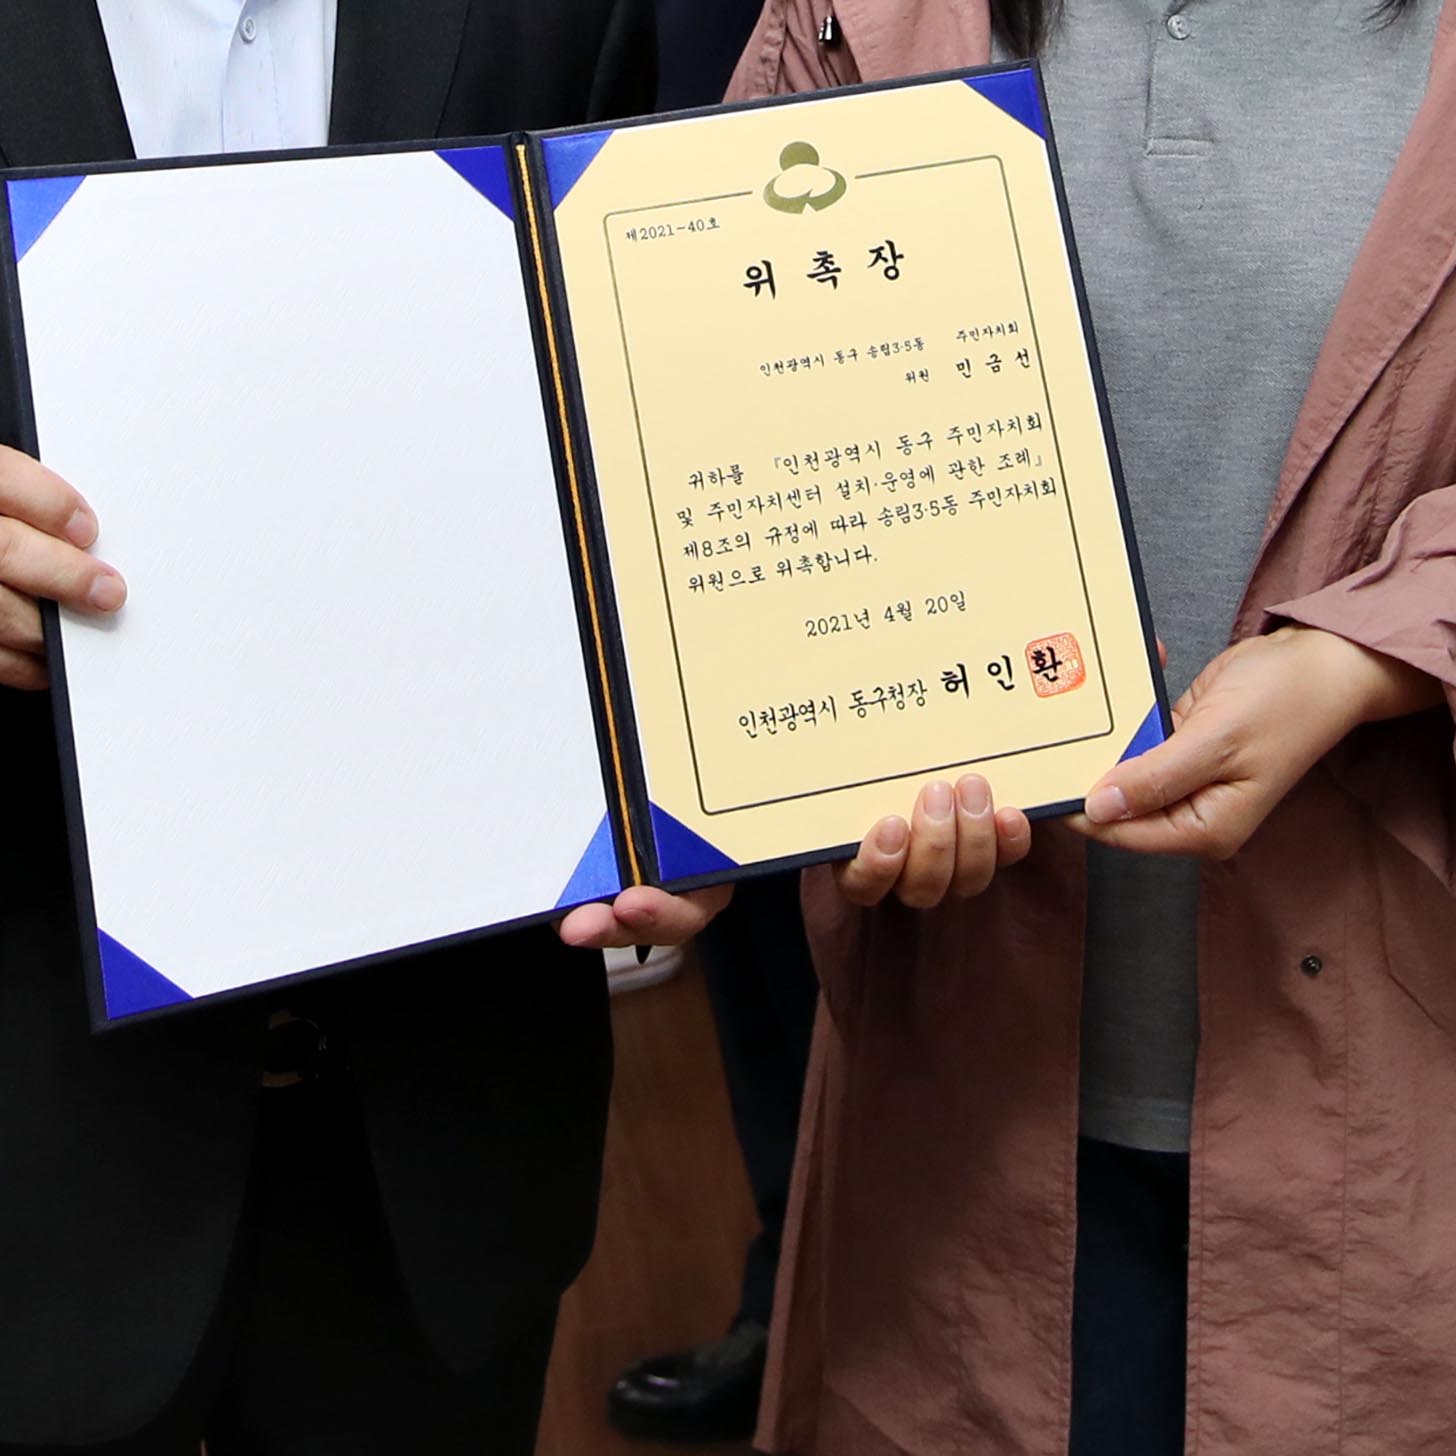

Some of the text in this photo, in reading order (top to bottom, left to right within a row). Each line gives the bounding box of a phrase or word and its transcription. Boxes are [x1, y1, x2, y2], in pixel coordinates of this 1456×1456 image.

[760, 353, 825, 377] 인천광역시
[833, 348, 859, 365] 동구
[956, 321, 1019, 343] 주민자치회
[905, 368, 930, 384] 위원
[688, 464, 744, 491] 귀하를
[896, 432, 933, 456] 동구
[946, 412, 1043, 446] 주민자치회
[676, 507, 693, 529] 및
[707, 485, 822, 523] 주민자치센터
[948, 456, 985, 480] 관한
[683, 531, 751, 560] 제8조의
[765, 519, 819, 546] 규정에
[830, 511, 868, 534] 따라
[968, 477, 1057, 510] 주민자치회
[688, 545, 878, 593] 위원으로 위촉합니다.
[805, 590, 967, 637] 2021년 4월 20일
[738, 695, 838, 739] 인천광역시
[848, 678, 928, 719] 동구청장
